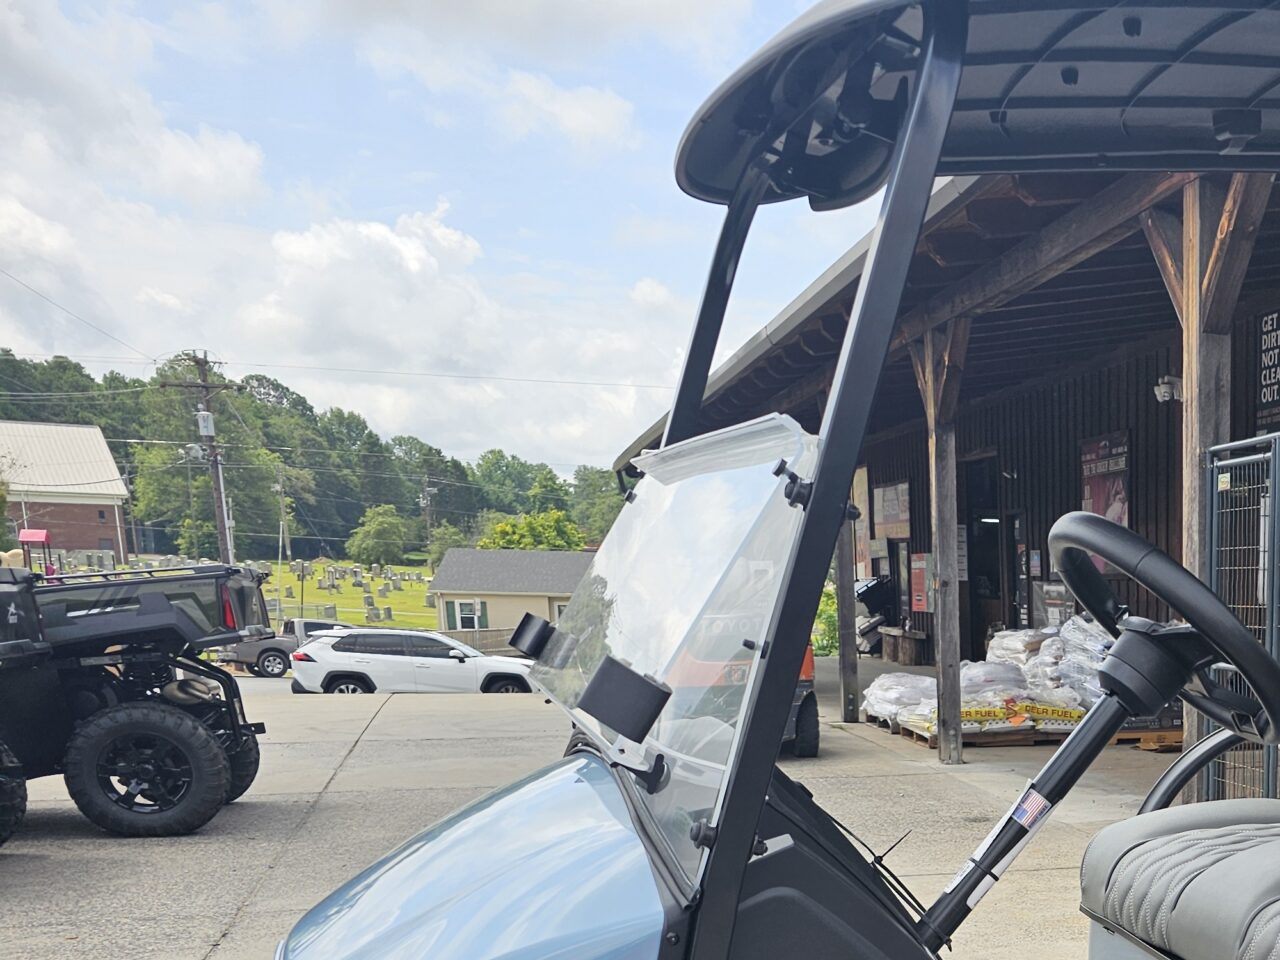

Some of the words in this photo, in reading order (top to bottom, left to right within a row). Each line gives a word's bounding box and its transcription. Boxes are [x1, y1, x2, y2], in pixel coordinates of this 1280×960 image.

[1262, 313, 1278, 332] GET
[1261, 351, 1279, 367] NOT
[1261, 385, 1280, 403] OUT.
[700, 617, 762, 634] TOYOT
[975, 710, 999, 718] FUEL
[1024, 705, 1049, 715] DEER
[1051, 709, 1075, 718] FUEL
